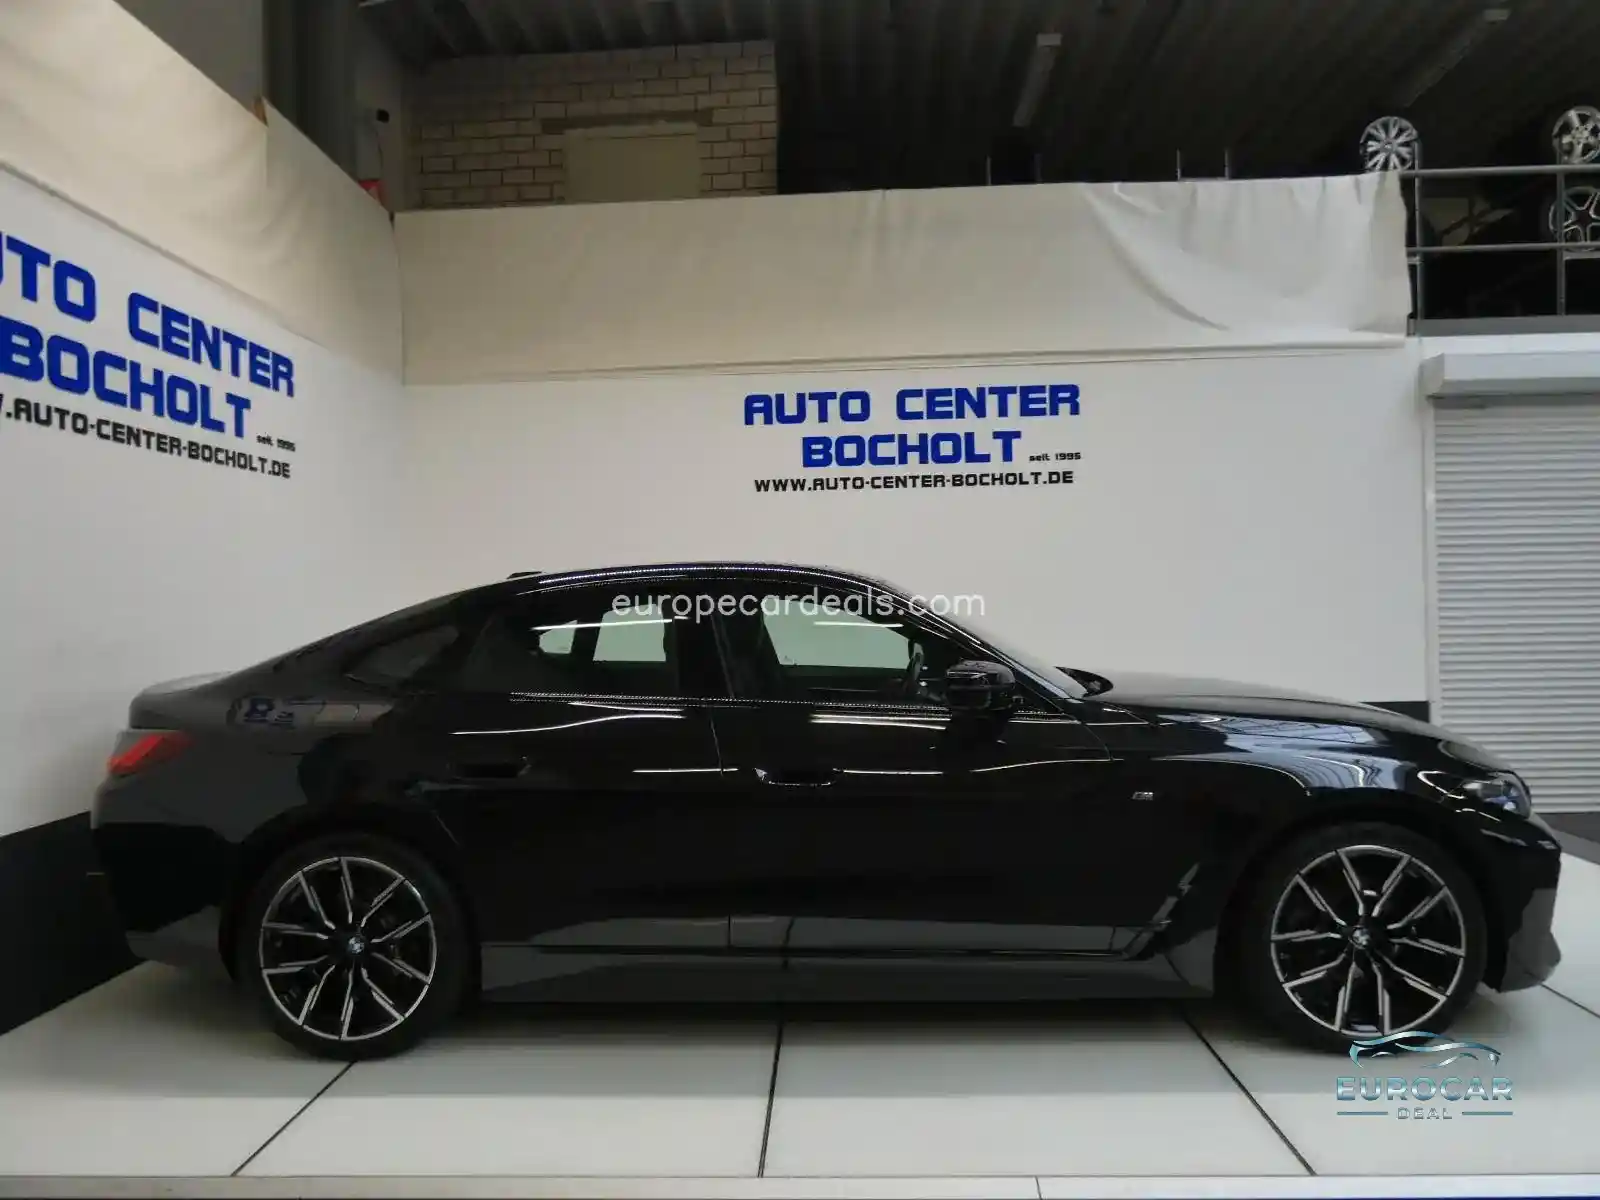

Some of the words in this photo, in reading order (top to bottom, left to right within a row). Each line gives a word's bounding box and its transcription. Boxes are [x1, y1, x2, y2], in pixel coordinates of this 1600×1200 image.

[0, 231, 96, 322] TO
[128, 292, 294, 397] CENTER
[0, 315, 251, 438] BOCHOLT
[744, 391, 870, 425] AUTO
[896, 384, 1080, 420] CENTER
[0, 393, 291, 479] .AUTO-CENTER-BOCHOLT.DE
[802, 431, 1021, 467] BOCHOLT
[1029, 453, 1050, 461] seit
[754, 471, 1073, 492] WWW.AUTO-CENTER-BOCHOLT.DE
